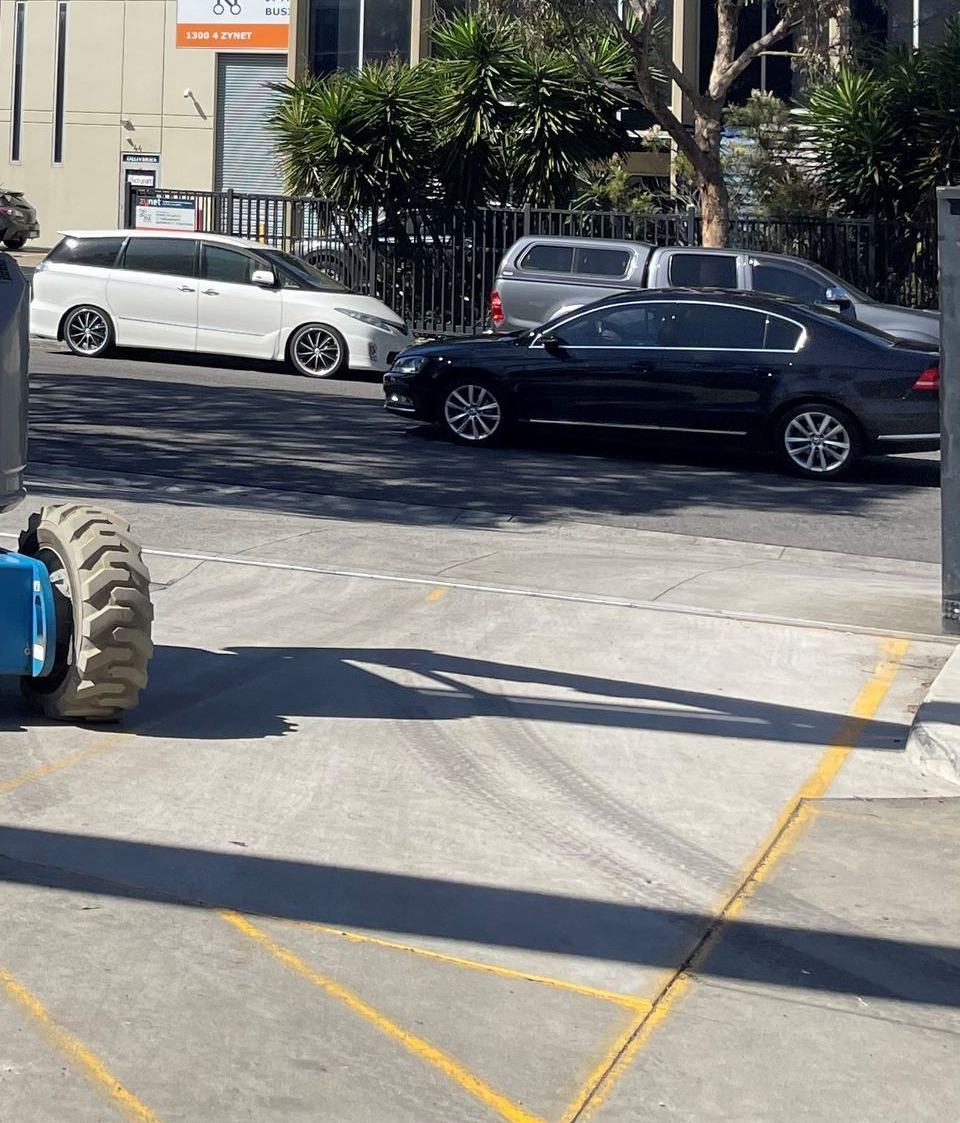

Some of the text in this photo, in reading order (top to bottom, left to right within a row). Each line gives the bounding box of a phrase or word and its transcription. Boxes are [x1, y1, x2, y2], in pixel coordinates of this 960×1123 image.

[186, 31, 252, 40] 1300 4 ZYNET
